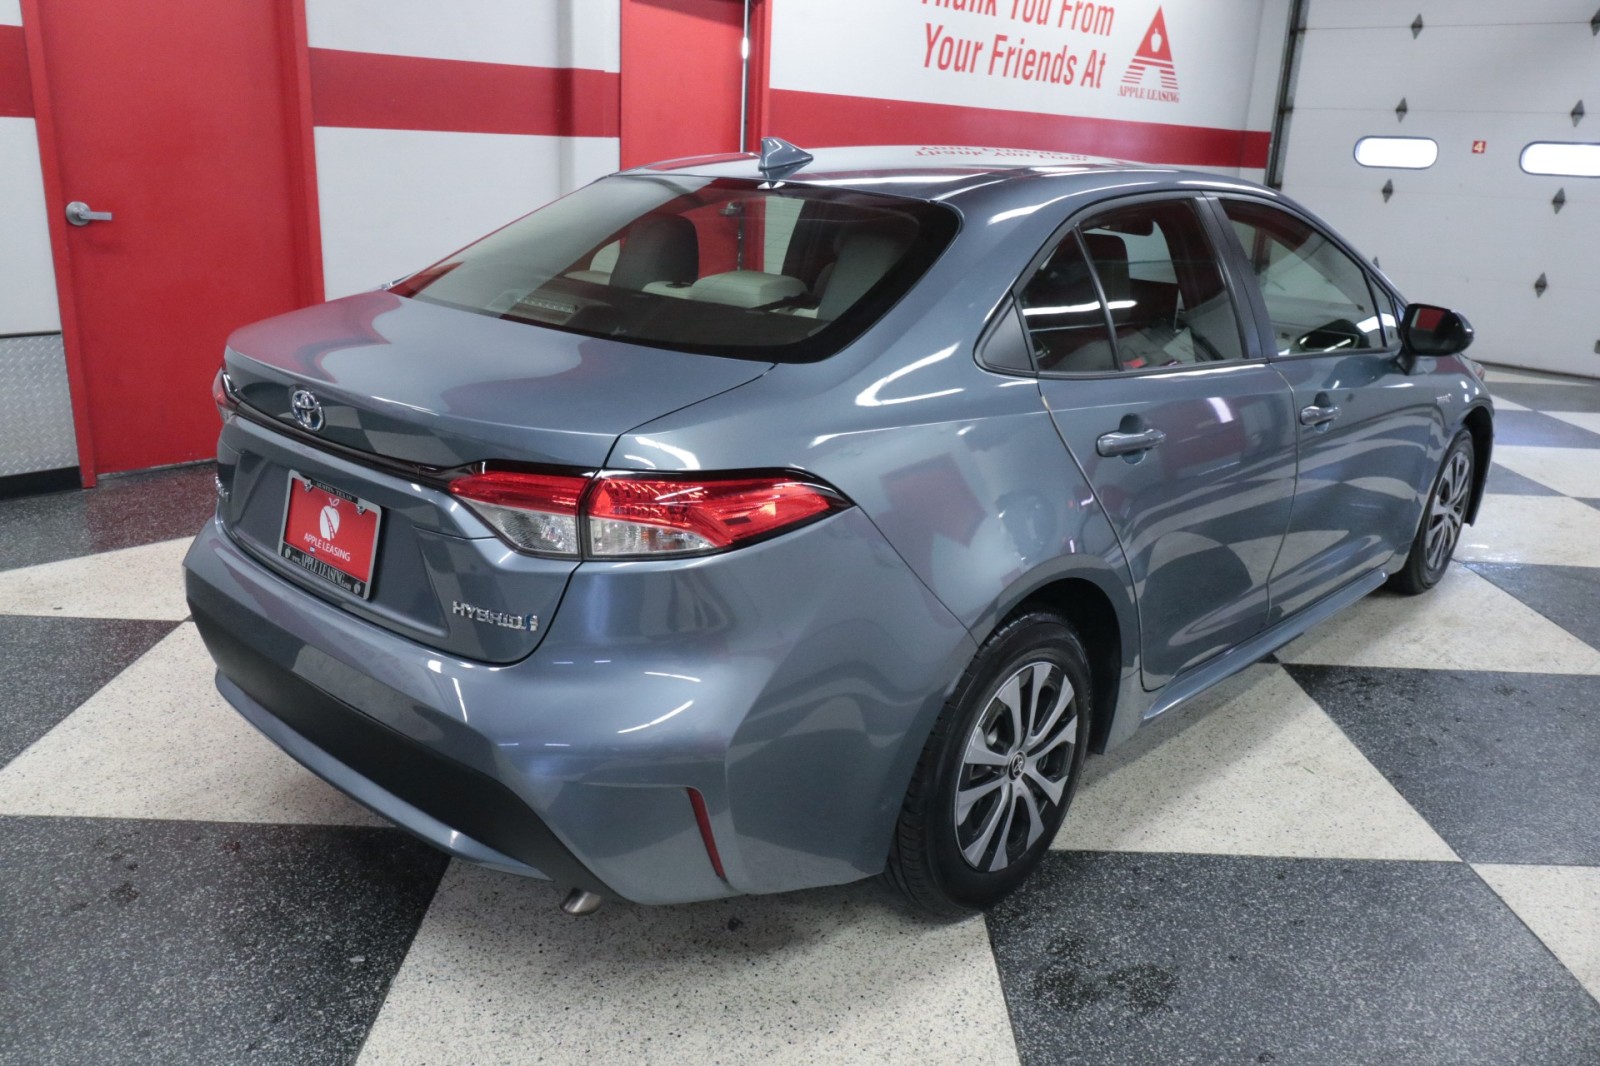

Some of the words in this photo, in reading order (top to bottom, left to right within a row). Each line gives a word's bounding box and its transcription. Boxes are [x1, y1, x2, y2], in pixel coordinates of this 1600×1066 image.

[1057, 0, 1115, 36] From
[924, 23, 983, 73] Your
[988, 34, 1077, 85] Friends
[1080, 50, 1106, 89] At
[1118, 85, 1145, 99] APPLE
[1146, 88, 1179, 103] LEASING
[303, 532, 322, 549] APPLE
[322, 541, 351, 562] LEASING
[452, 600, 526, 630] HYBRID
